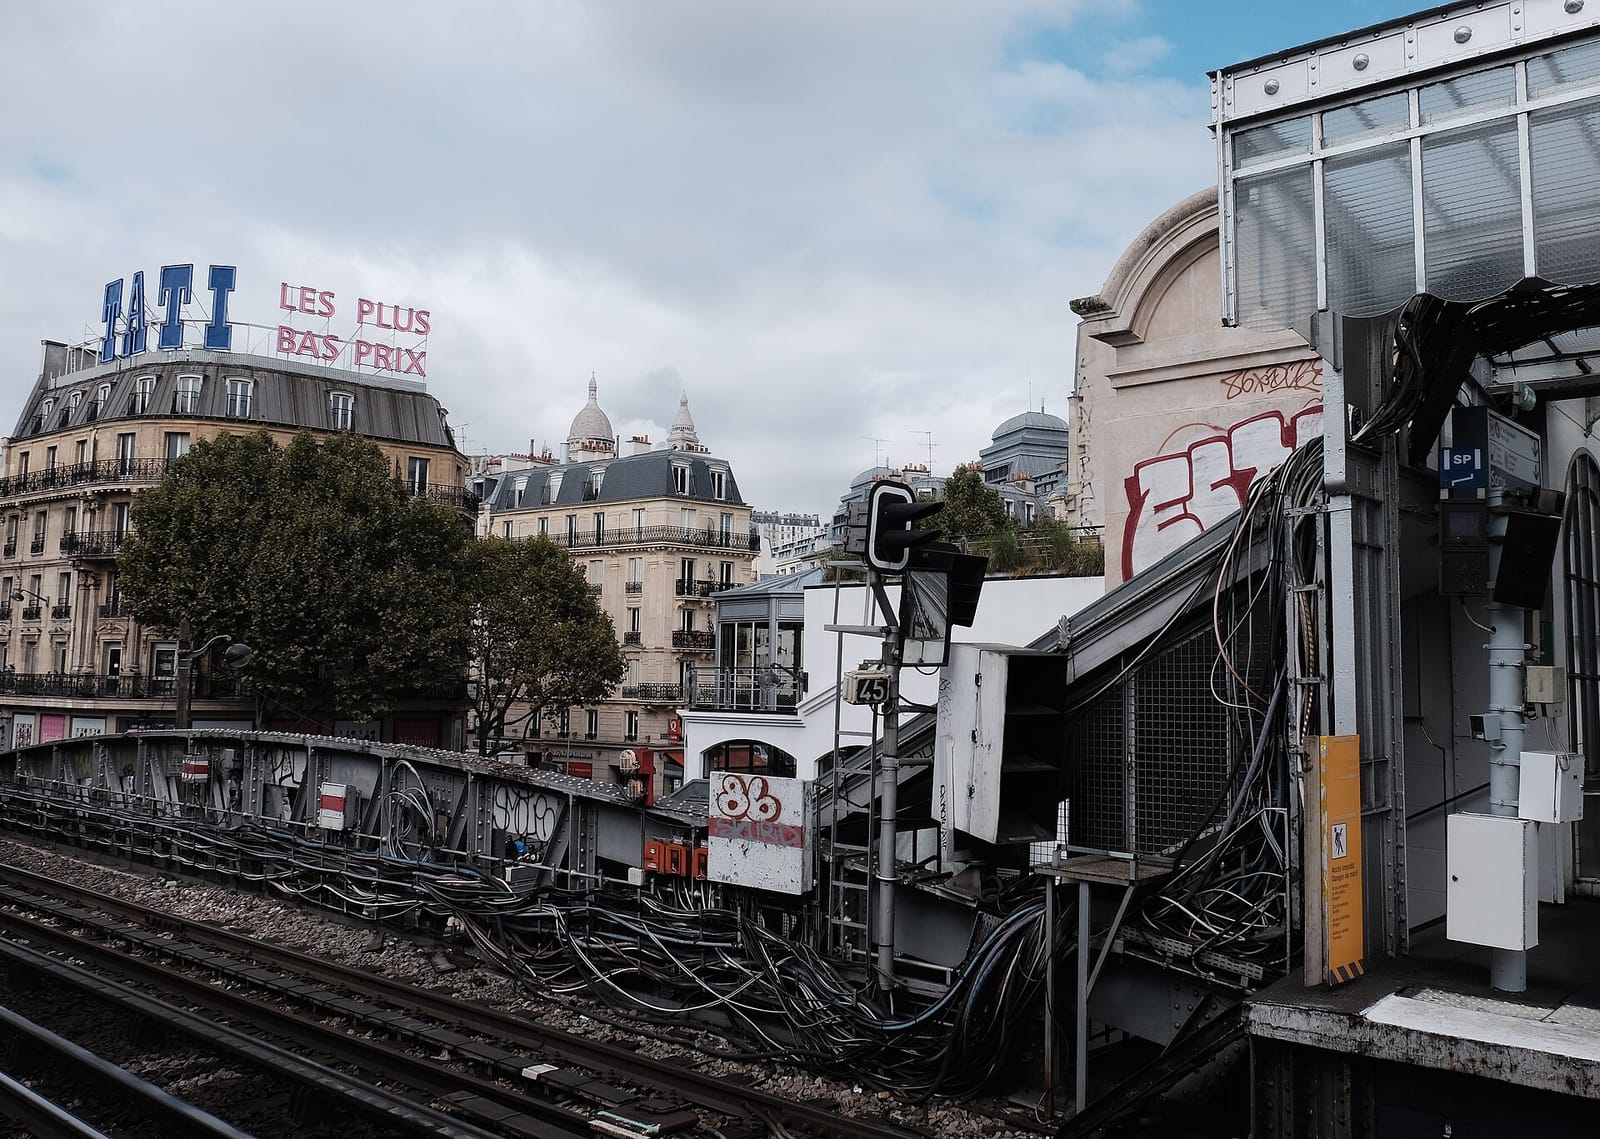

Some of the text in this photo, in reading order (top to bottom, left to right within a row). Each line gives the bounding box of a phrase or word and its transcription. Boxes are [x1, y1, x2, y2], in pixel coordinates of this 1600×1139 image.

[101, 264, 237, 362] TATI
[280, 282, 430, 336] LES PLUS
[277, 325, 427, 377] BAS PRIX
[1453, 454, 1472, 464] SP
[859, 680, 885, 701] 45
